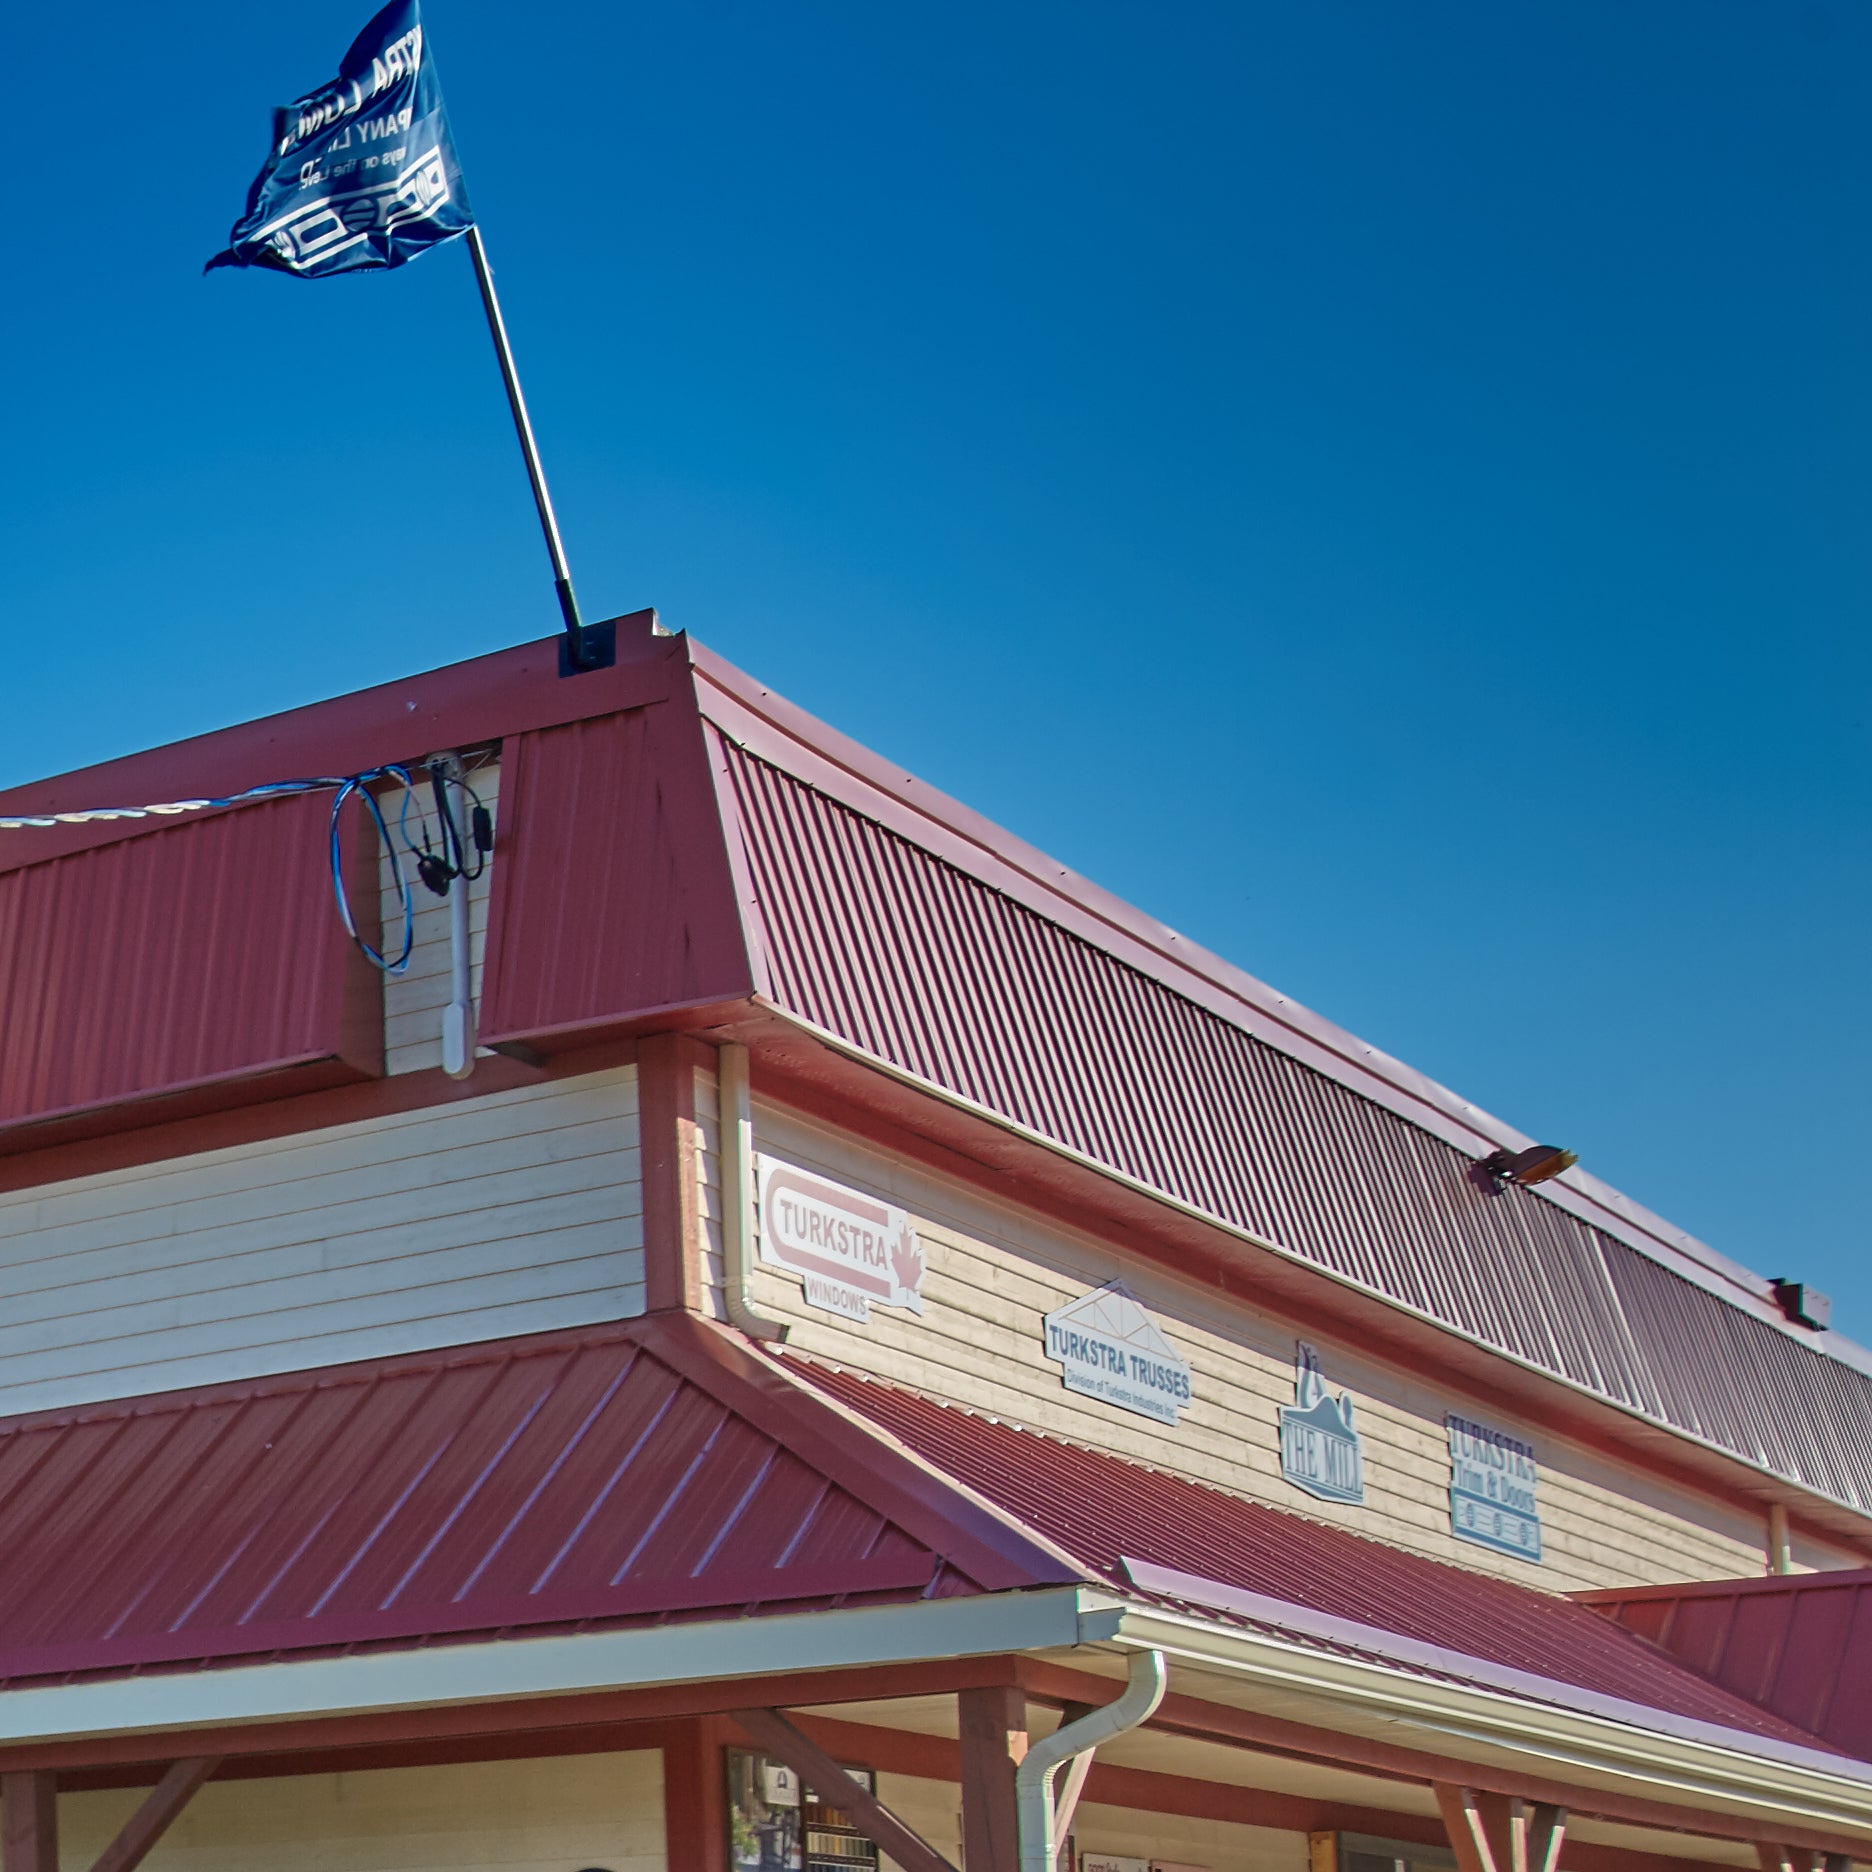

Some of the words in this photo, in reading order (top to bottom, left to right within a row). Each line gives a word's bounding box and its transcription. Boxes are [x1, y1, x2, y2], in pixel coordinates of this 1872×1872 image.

[780, 1198, 888, 1271] TURKSTRA
[807, 1276, 867, 1316] WINDOWS
[1049, 1325, 1127, 1377] TURKSTRA
[1130, 1355, 1190, 1400] TRUSSES
[1284, 1420, 1317, 1478] THE
[1325, 1434, 1362, 1494] MILL
[1448, 1415, 1536, 1483] TURKSTRA
[1455, 1457, 1484, 1494] Trim
[1501, 1476, 1536, 1513] Doors
